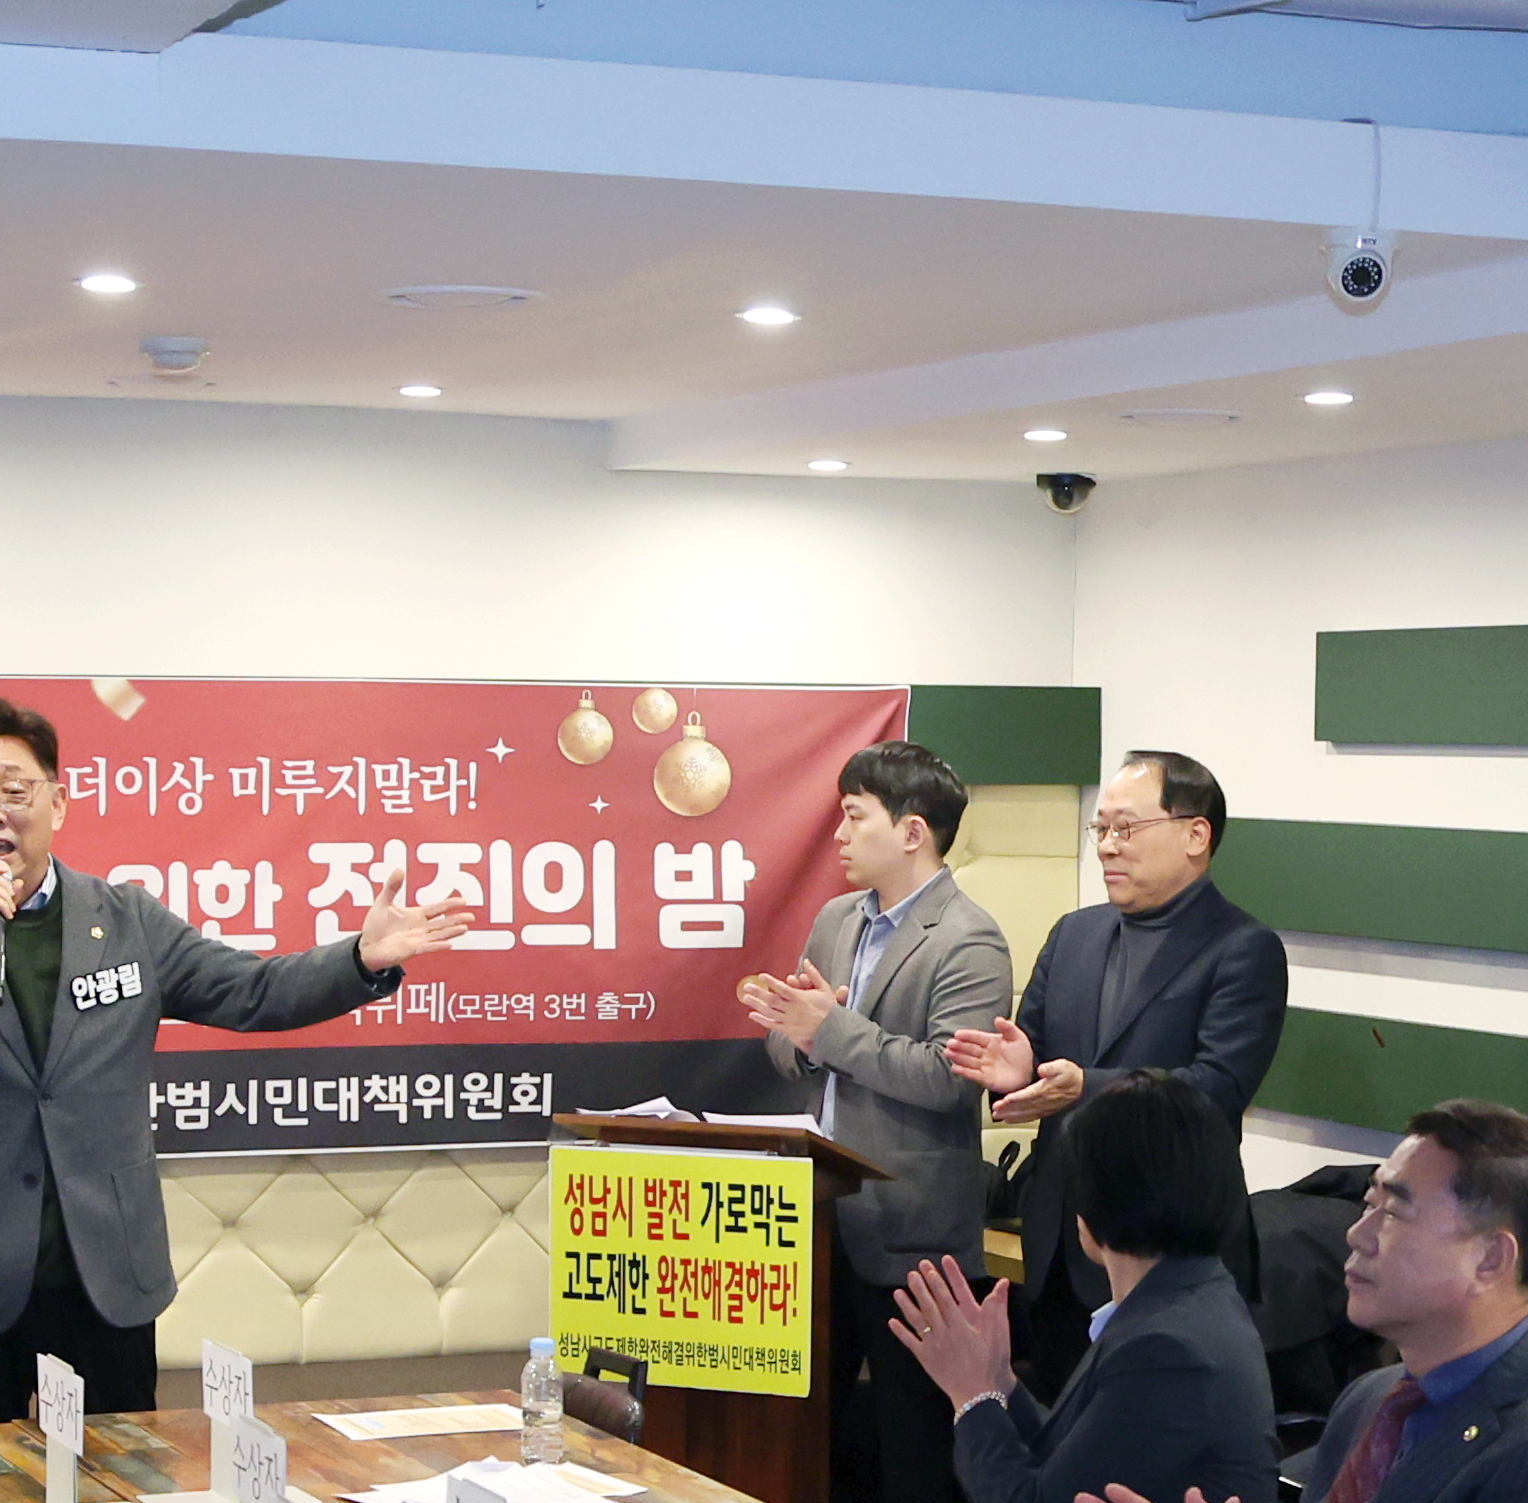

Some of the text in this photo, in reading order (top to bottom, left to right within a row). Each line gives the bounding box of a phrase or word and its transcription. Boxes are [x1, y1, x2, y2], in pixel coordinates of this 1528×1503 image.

[65, 755, 214, 818] 더이상
[230, 755, 479, 817] 미루지말라!
[307, 838, 617, 951] 전진의
[654, 838, 757, 950] 밤
[71, 961, 143, 1011] 안광림
[543, 991, 587, 1021] 3번
[594, 990, 657, 1023] 출구)
[563, 1172, 799, 1249] 성남시 발전 가로막는
[562, 1250, 799, 1327] 고도제한 완전해결하라!
[39, 1372, 82, 1441] 수상자
[205, 1358, 250, 1417] 수상자
[232, 1434, 280, 1501] 수상자
